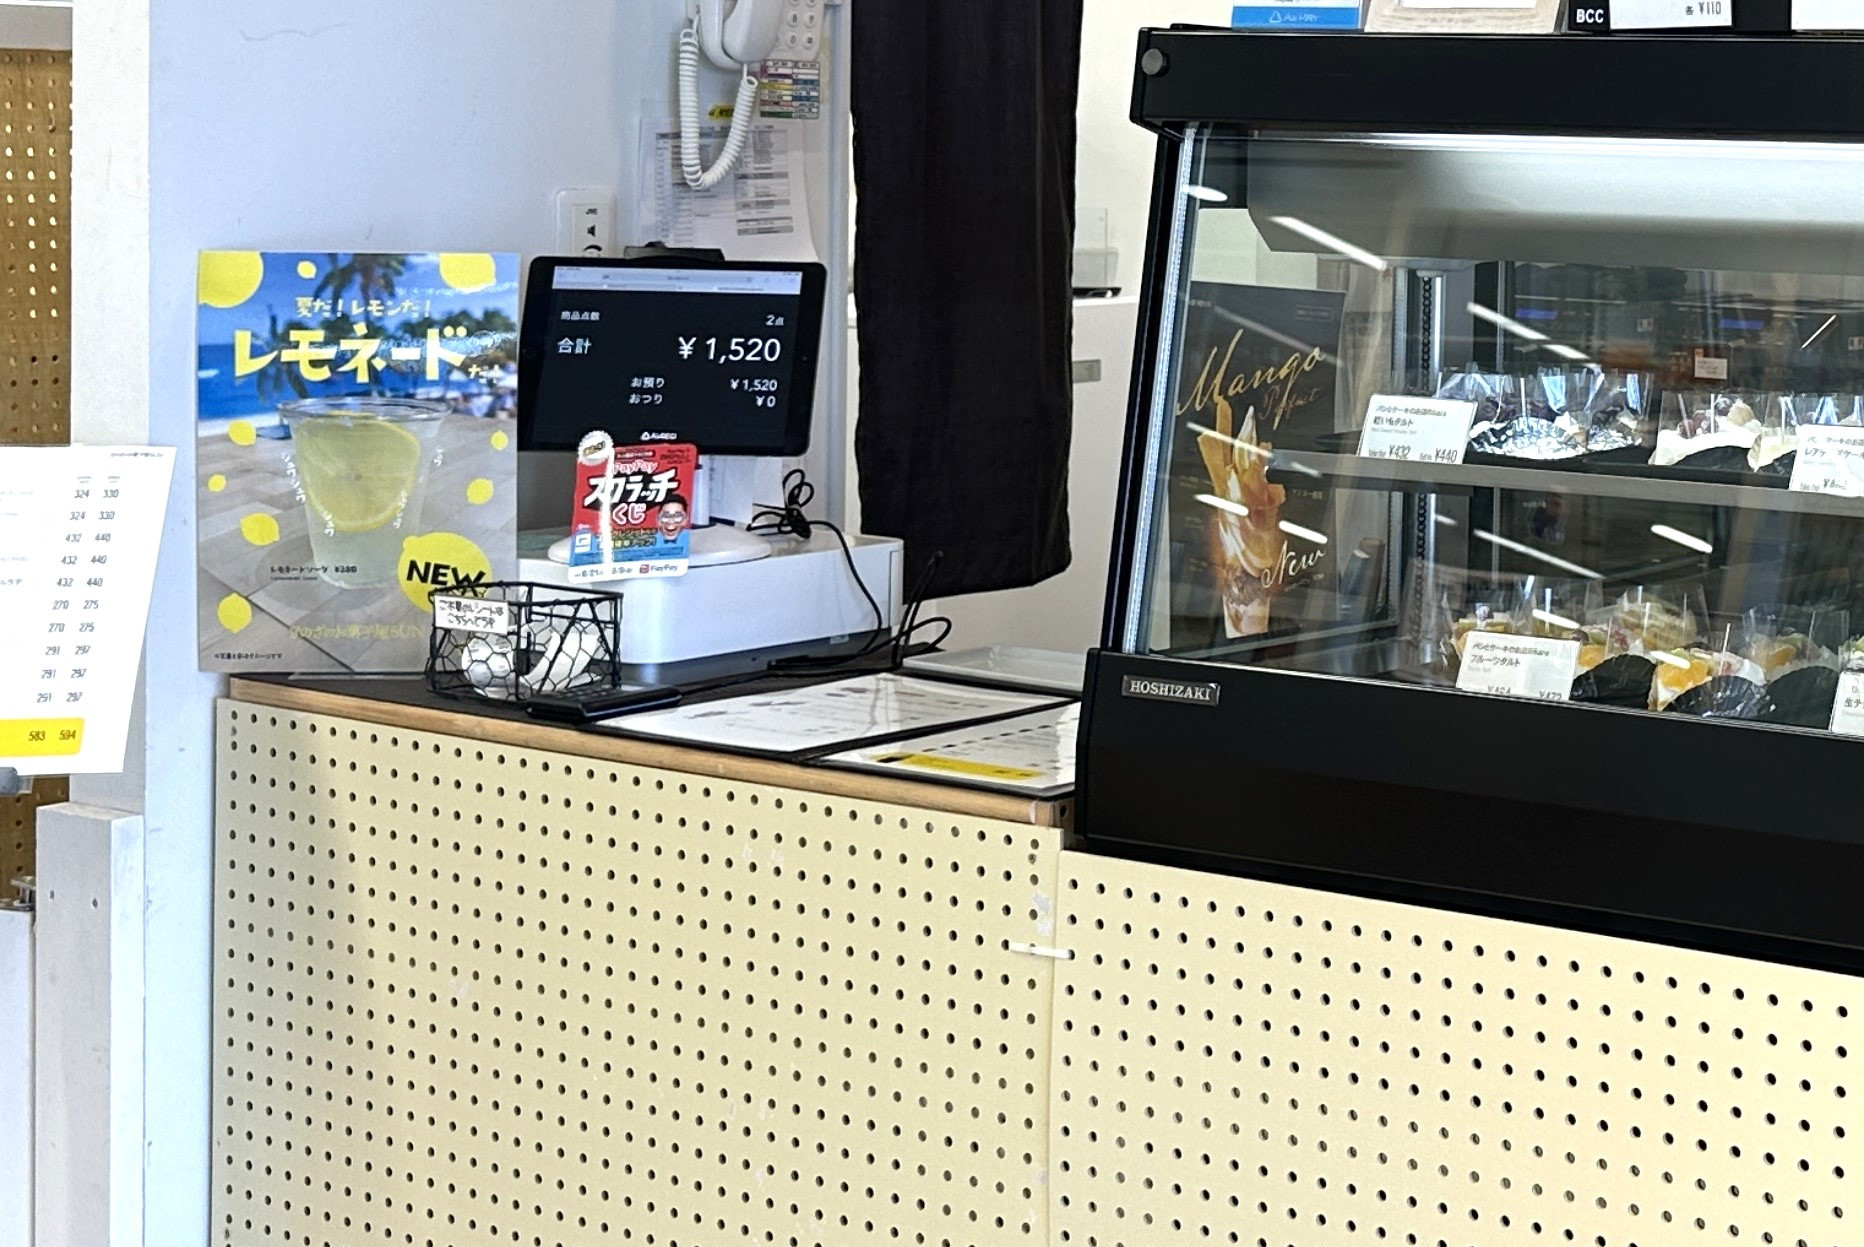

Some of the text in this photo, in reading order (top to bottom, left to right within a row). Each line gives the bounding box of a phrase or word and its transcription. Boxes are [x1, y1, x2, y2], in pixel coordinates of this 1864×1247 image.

[1698, 1, 1722, 15] ¥110
[1576, 9, 1604, 24] BCC
[560, 310, 600, 321] 商品点数
[765, 314, 785, 326] 2点
[234, 322, 468, 383] レモネード
[557, 337, 592, 354] 合計
[631, 377, 665, 389] お預り
[1175, 329, 1326, 431] Mango
[629, 393, 663, 404] おつり
[1389, 444, 1411, 459] ¥432
[1435, 447, 1458, 463] ¥440
[612, 502, 647, 525] くじ
[1261, 539, 1327, 589] New
[406, 559, 486, 597] NEW
[1471, 654, 1520, 668] フルーツタルト
[1129, 680, 1212, 701] HOSHIZAKI
